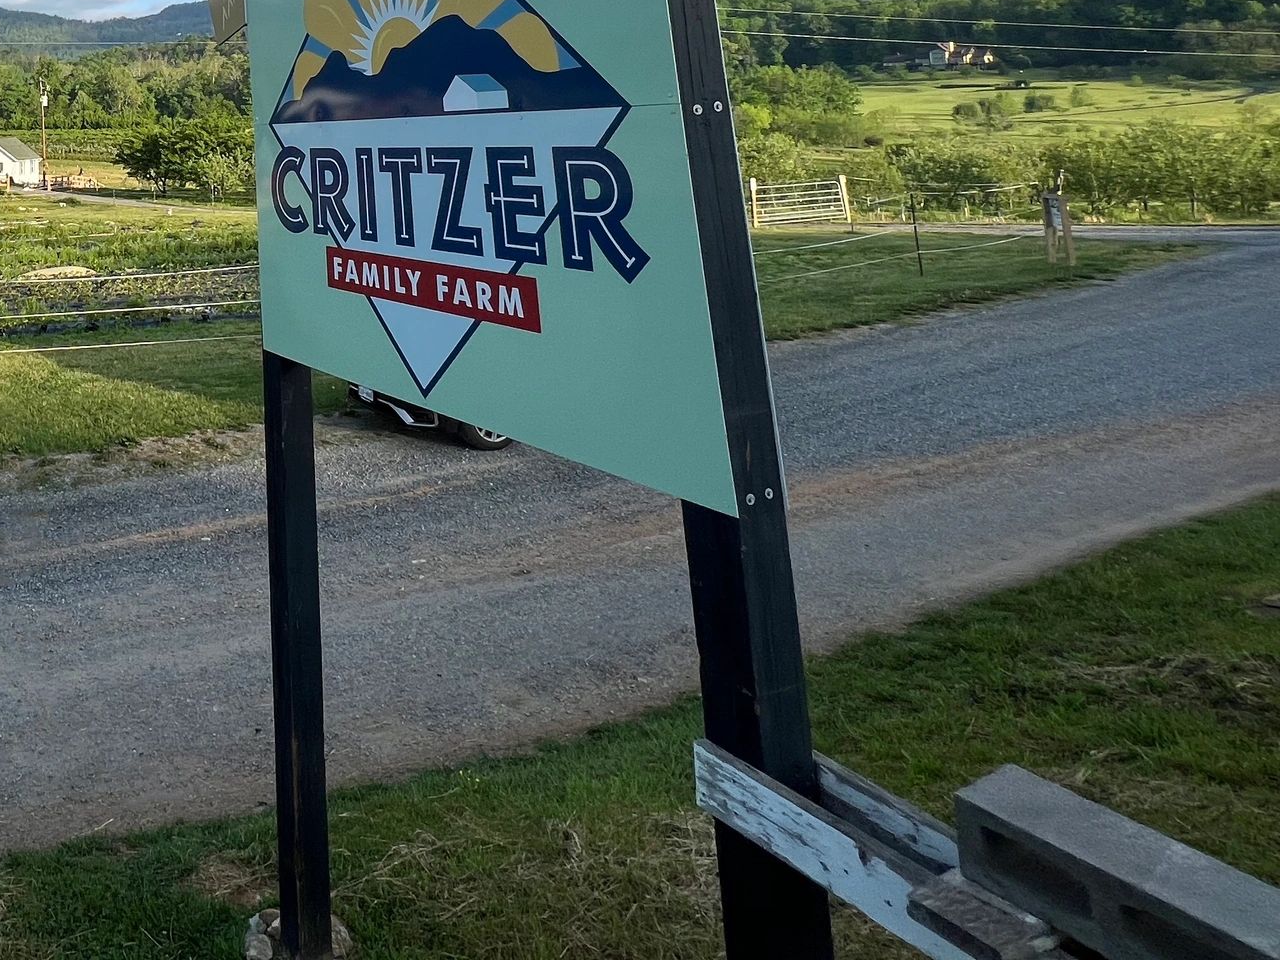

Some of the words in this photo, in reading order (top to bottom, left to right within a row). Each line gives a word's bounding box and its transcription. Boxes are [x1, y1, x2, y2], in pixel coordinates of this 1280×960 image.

[272, 146, 651, 284] CRITZER
[333, 256, 421, 297] FAMILY
[436, 274, 524, 318] FARM
